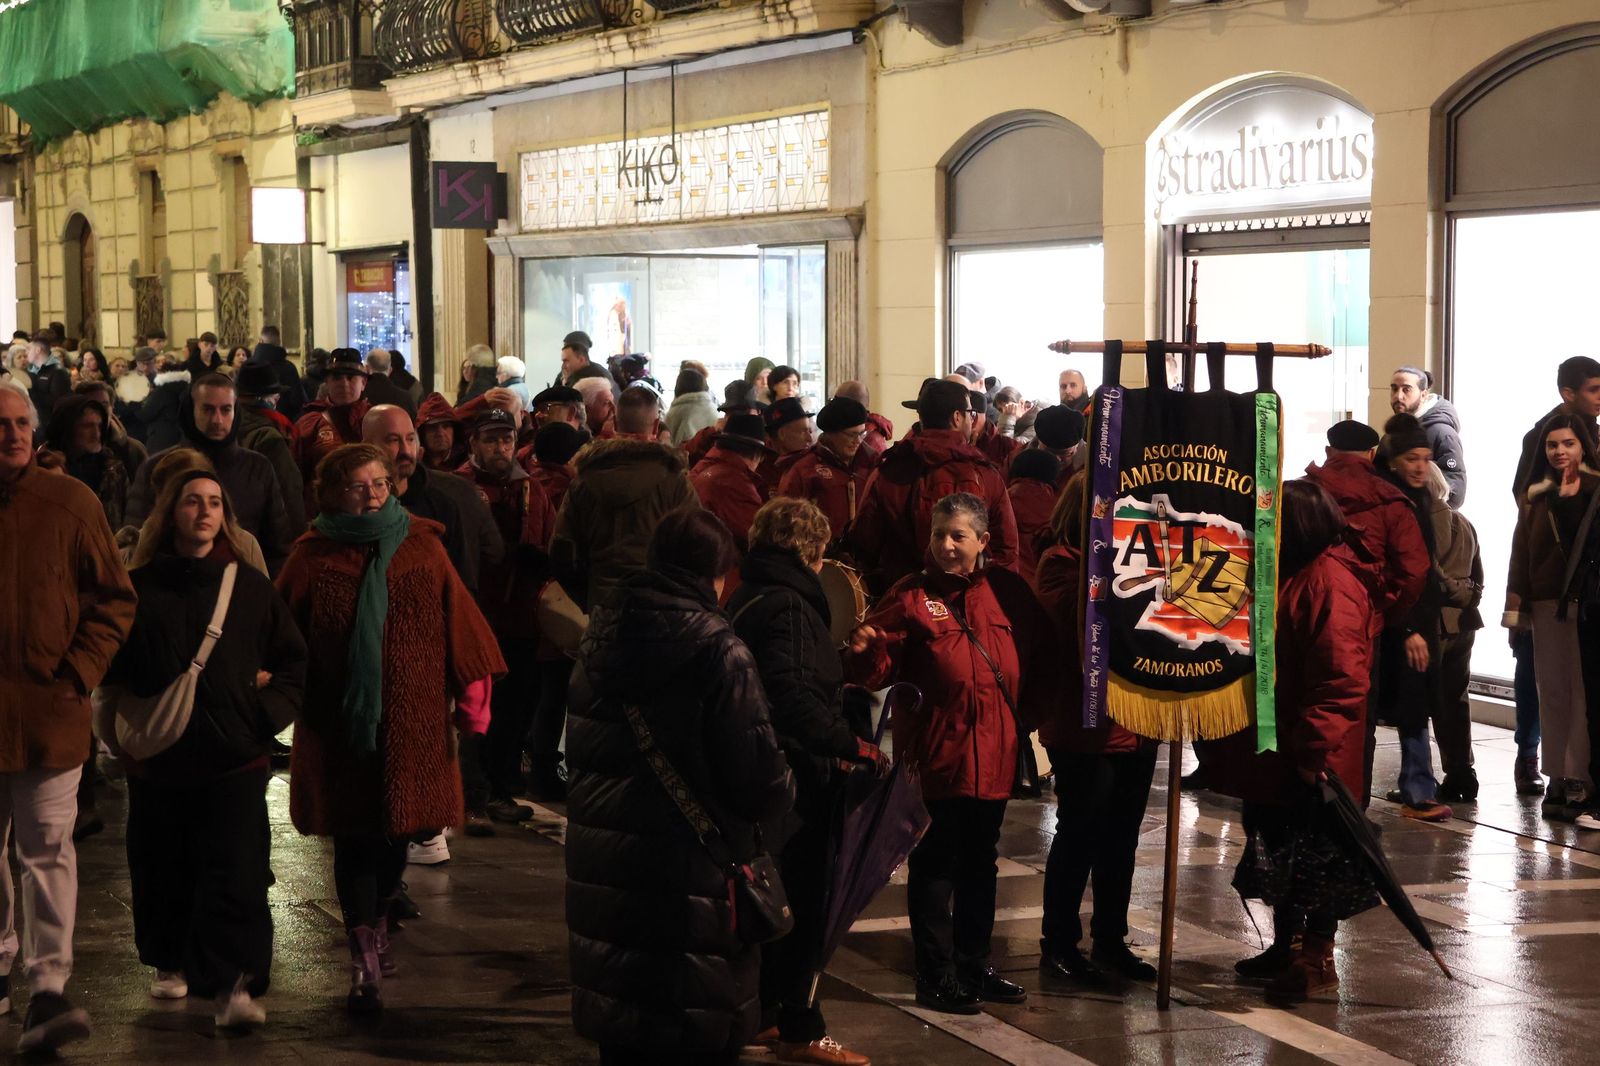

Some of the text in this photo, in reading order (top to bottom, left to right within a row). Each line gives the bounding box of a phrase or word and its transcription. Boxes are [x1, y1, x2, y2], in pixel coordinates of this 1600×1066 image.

[618, 144, 678, 189] KIKO
[1099, 389, 1121, 469] Hermanamiento
[1256, 399, 1277, 479] Hermanamiento
[1144, 443, 1228, 464] ASOCIACIÓN
[1117, 460, 1255, 495] AMBORILERO
[1133, 656, 1224, 677] ZAMORANOS
